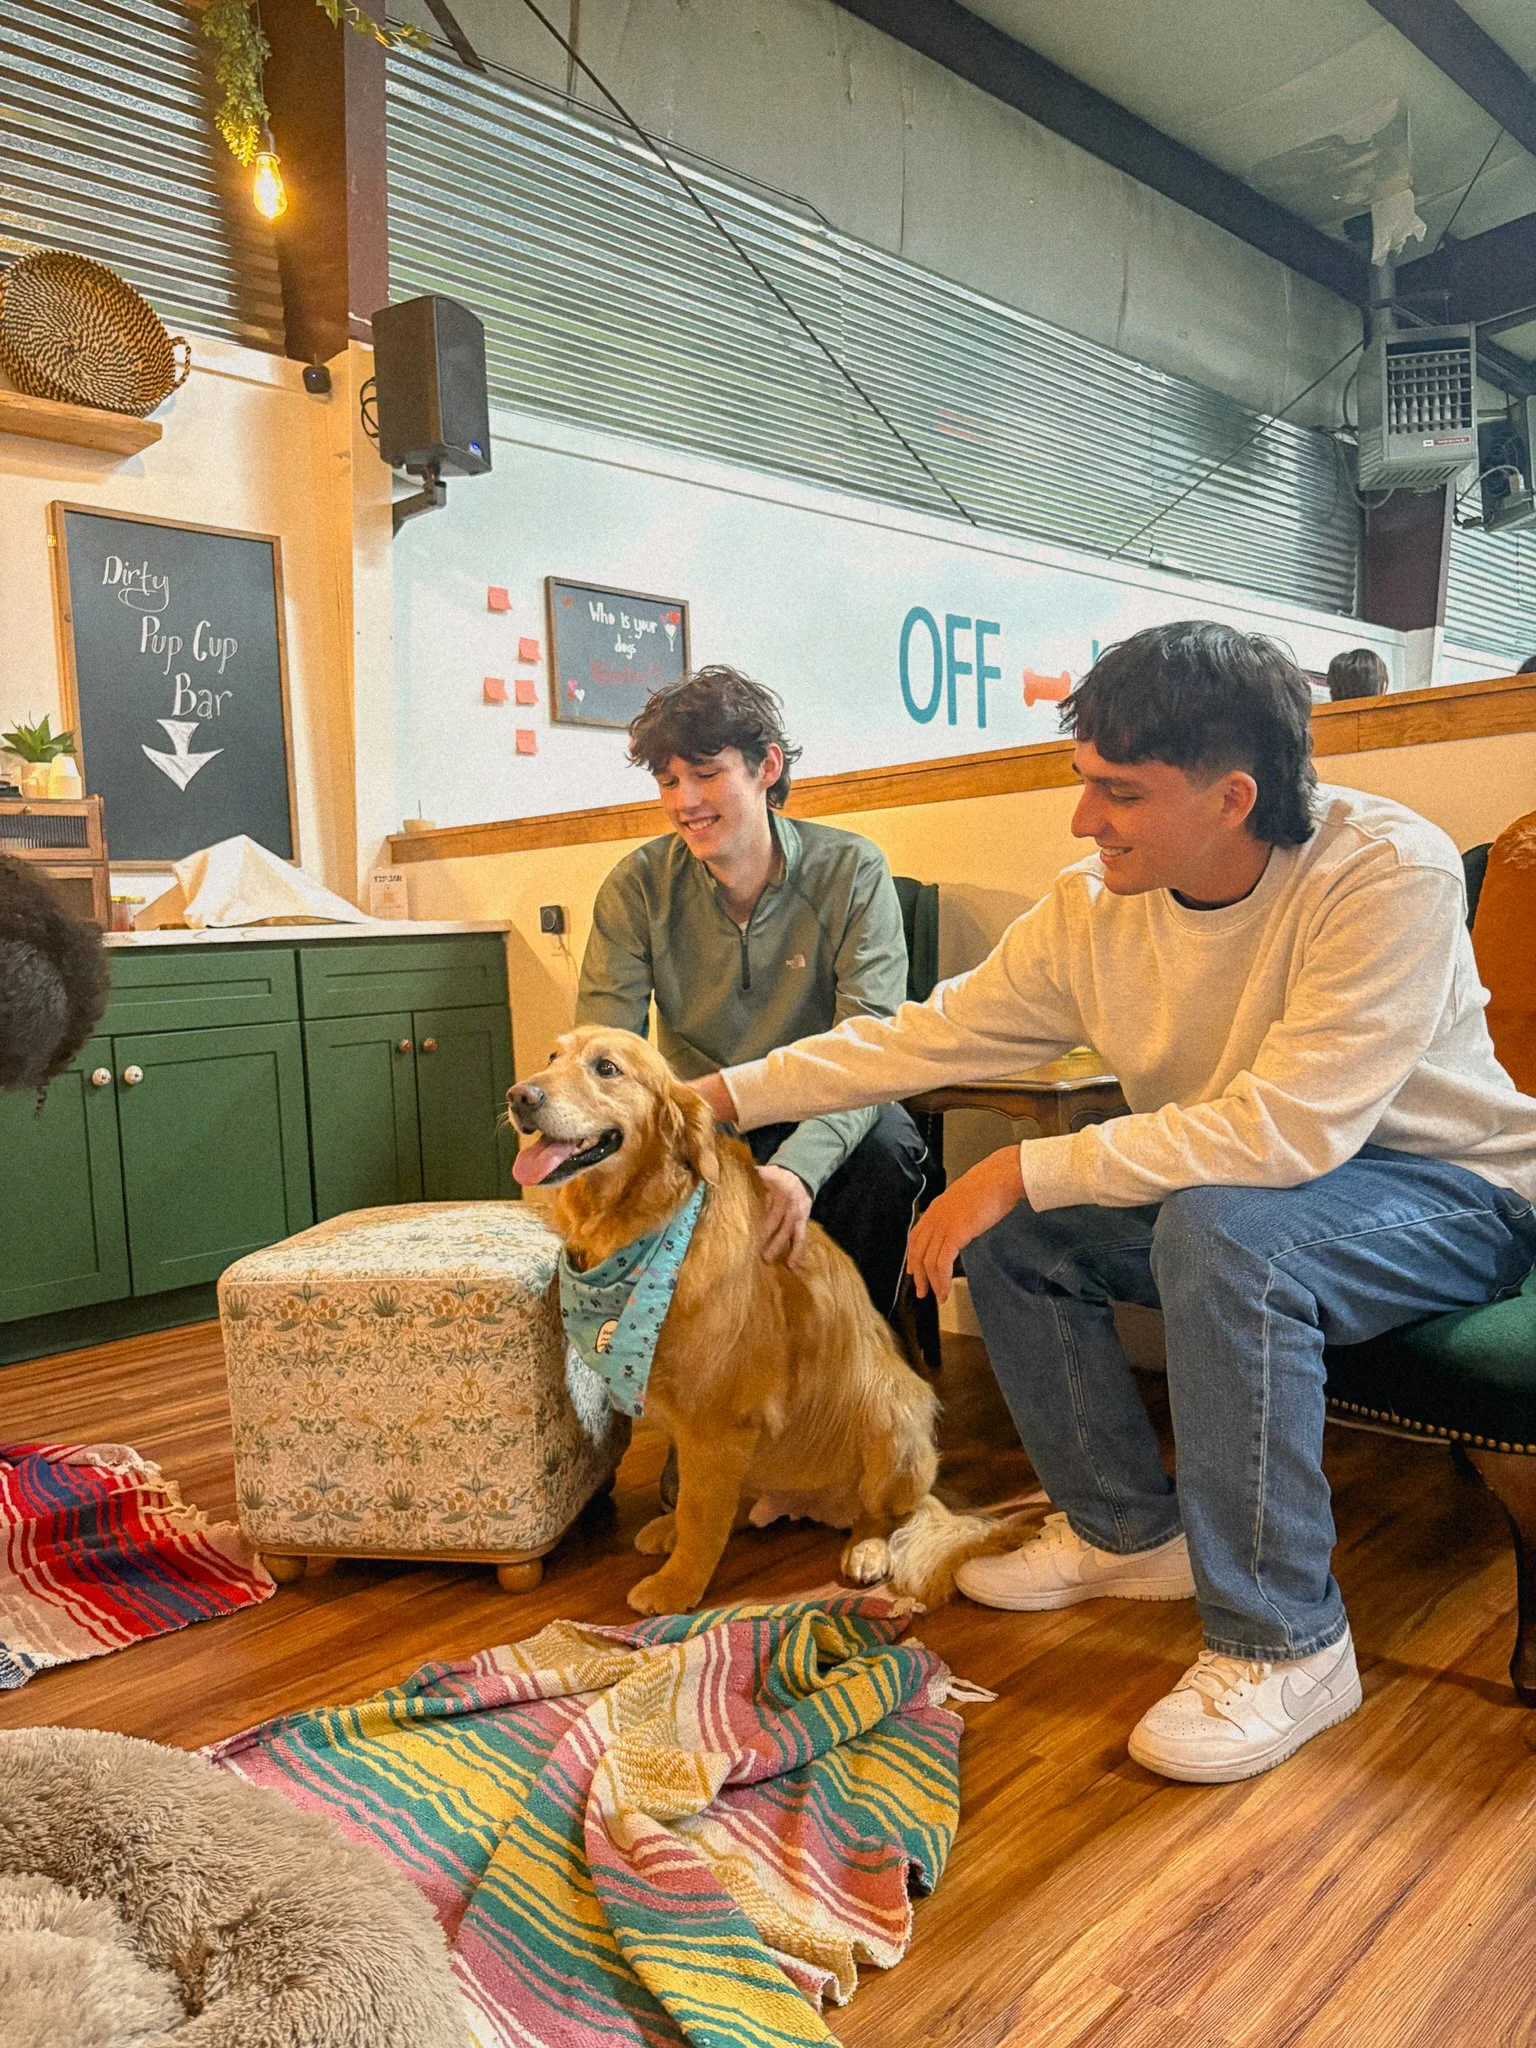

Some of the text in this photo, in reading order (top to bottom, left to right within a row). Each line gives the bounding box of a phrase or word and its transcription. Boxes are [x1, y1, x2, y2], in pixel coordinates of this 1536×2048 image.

[102, 555, 170, 613] Dirty
[140, 615, 239, 676] Pup Cup
[588, 601, 658, 639] Who is your
[171, 672, 233, 720] Bar
[899, 606, 1001, 729] OFF
